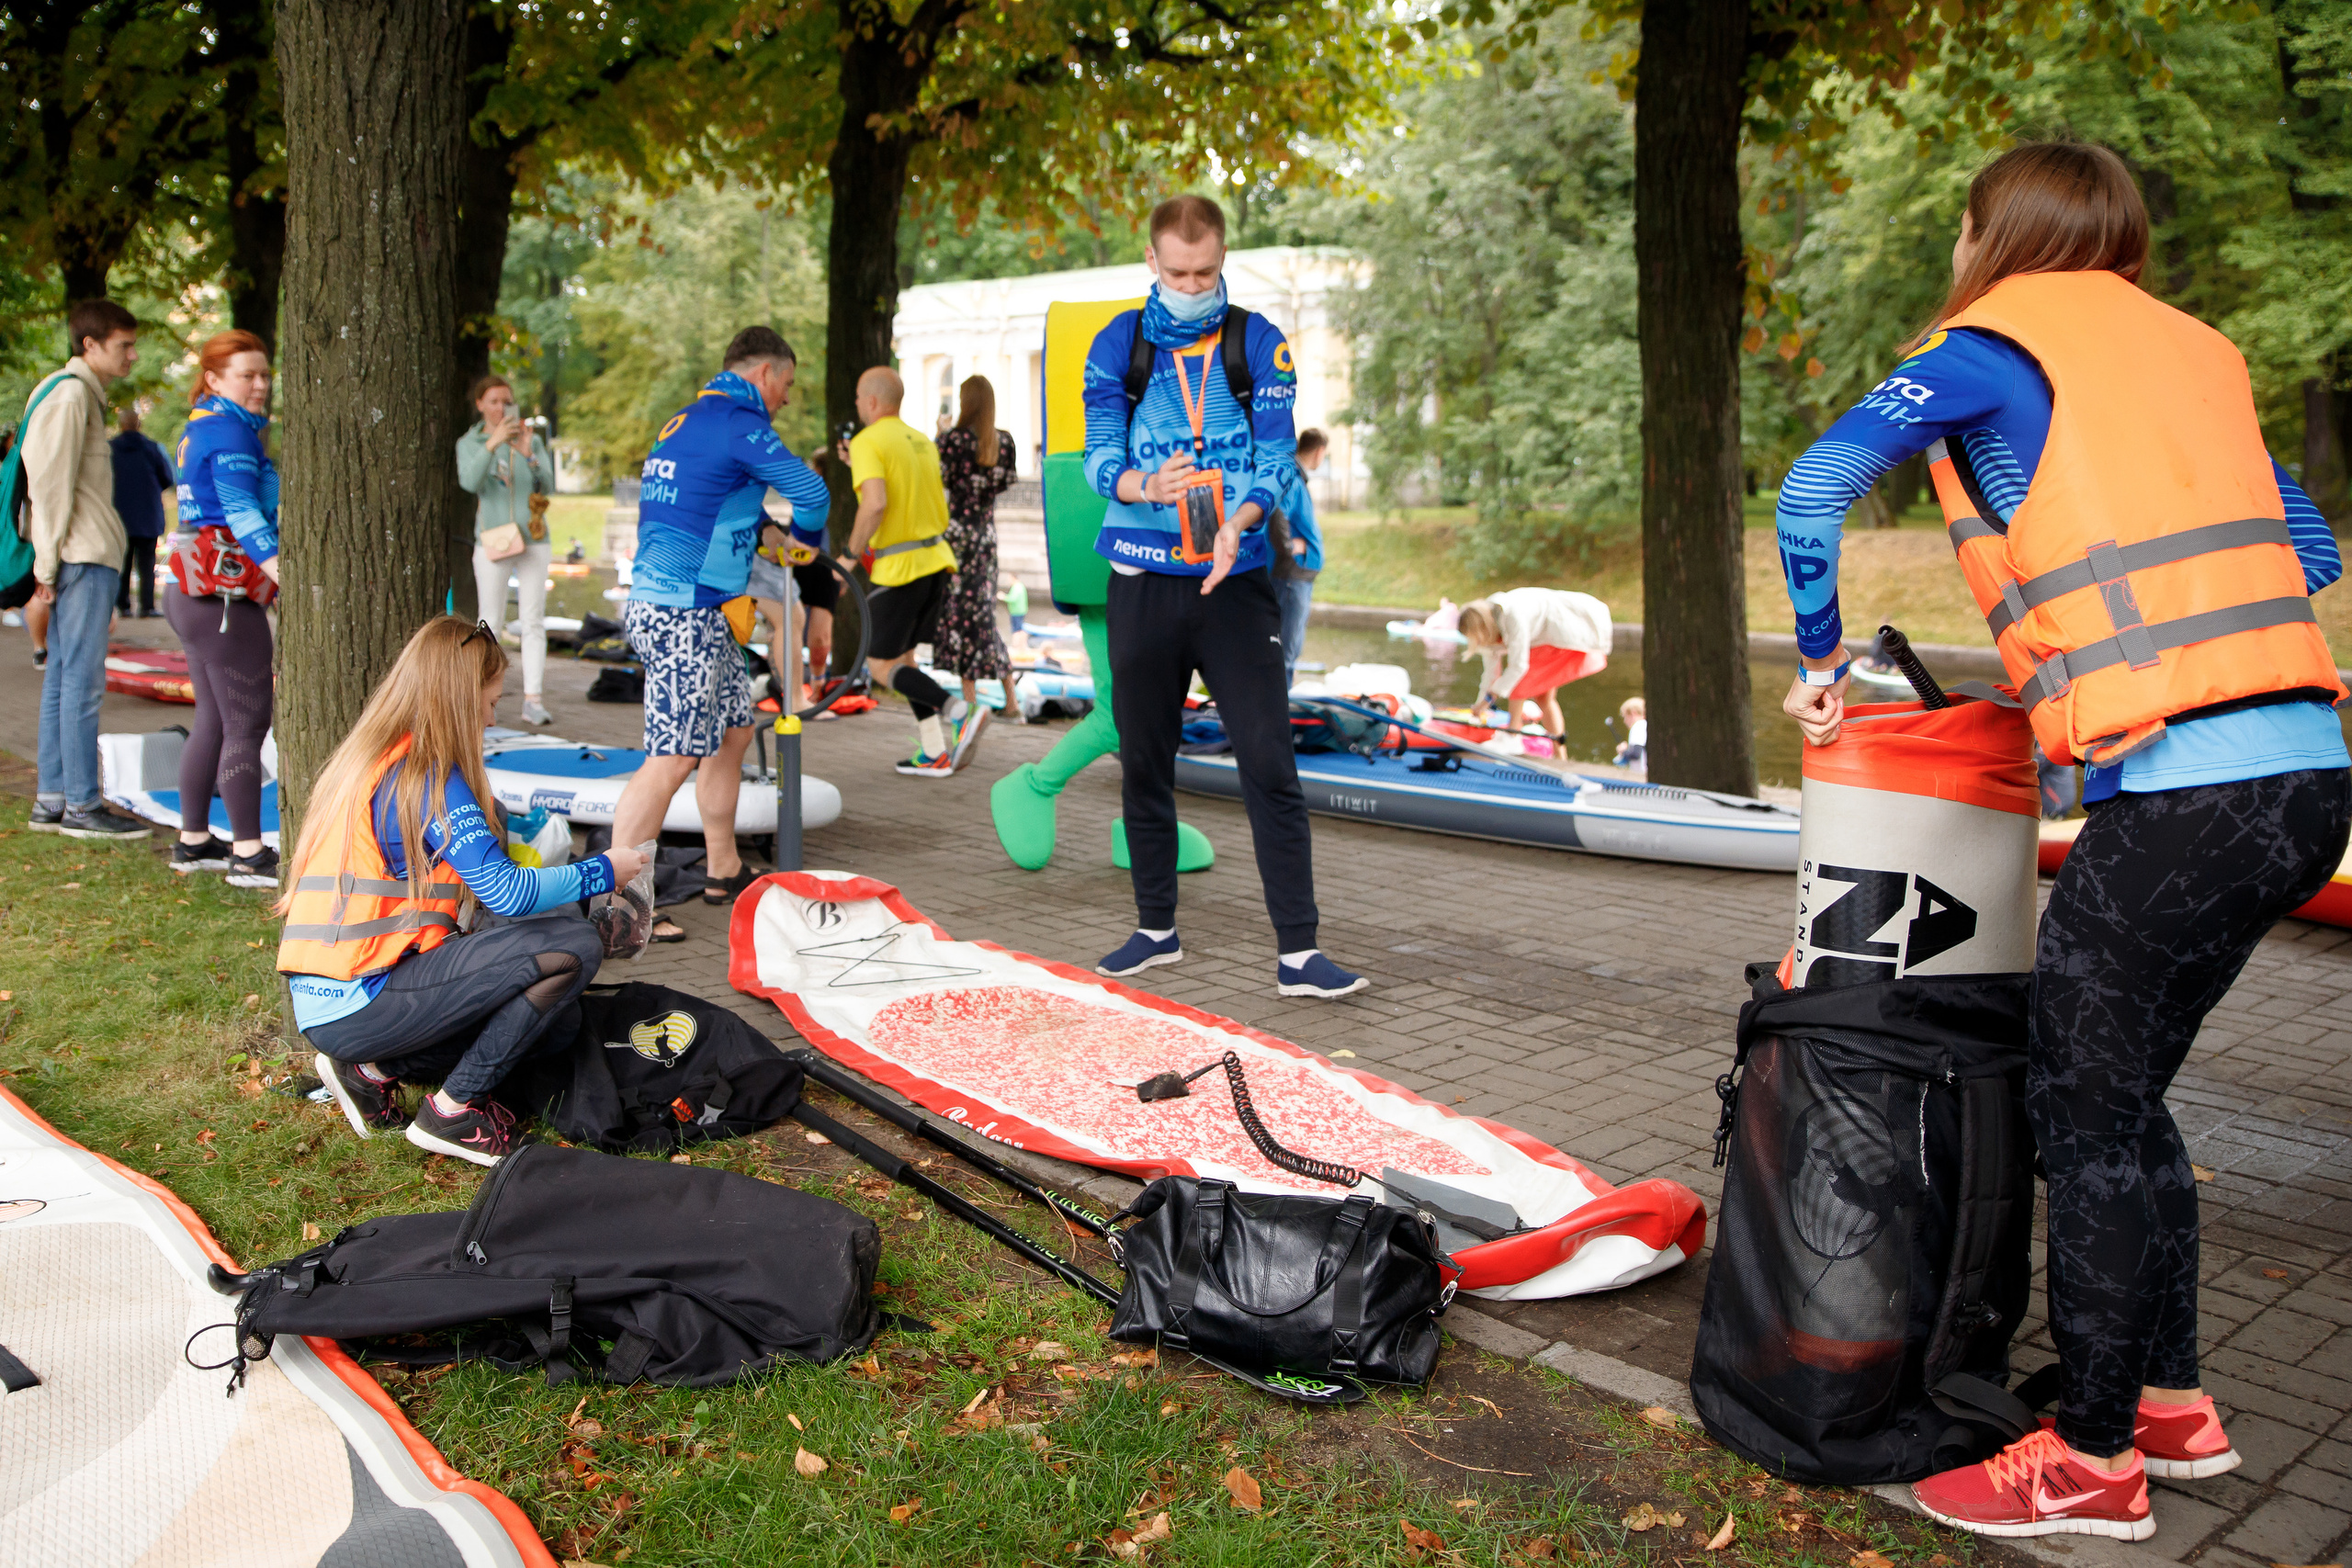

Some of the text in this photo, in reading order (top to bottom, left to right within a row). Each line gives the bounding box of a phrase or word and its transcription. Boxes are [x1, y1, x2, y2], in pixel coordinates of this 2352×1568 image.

[1113, 538, 1167, 564] лента
[1329, 794, 1377, 813] ITIWIT
[1796, 859, 1813, 964] STAND
